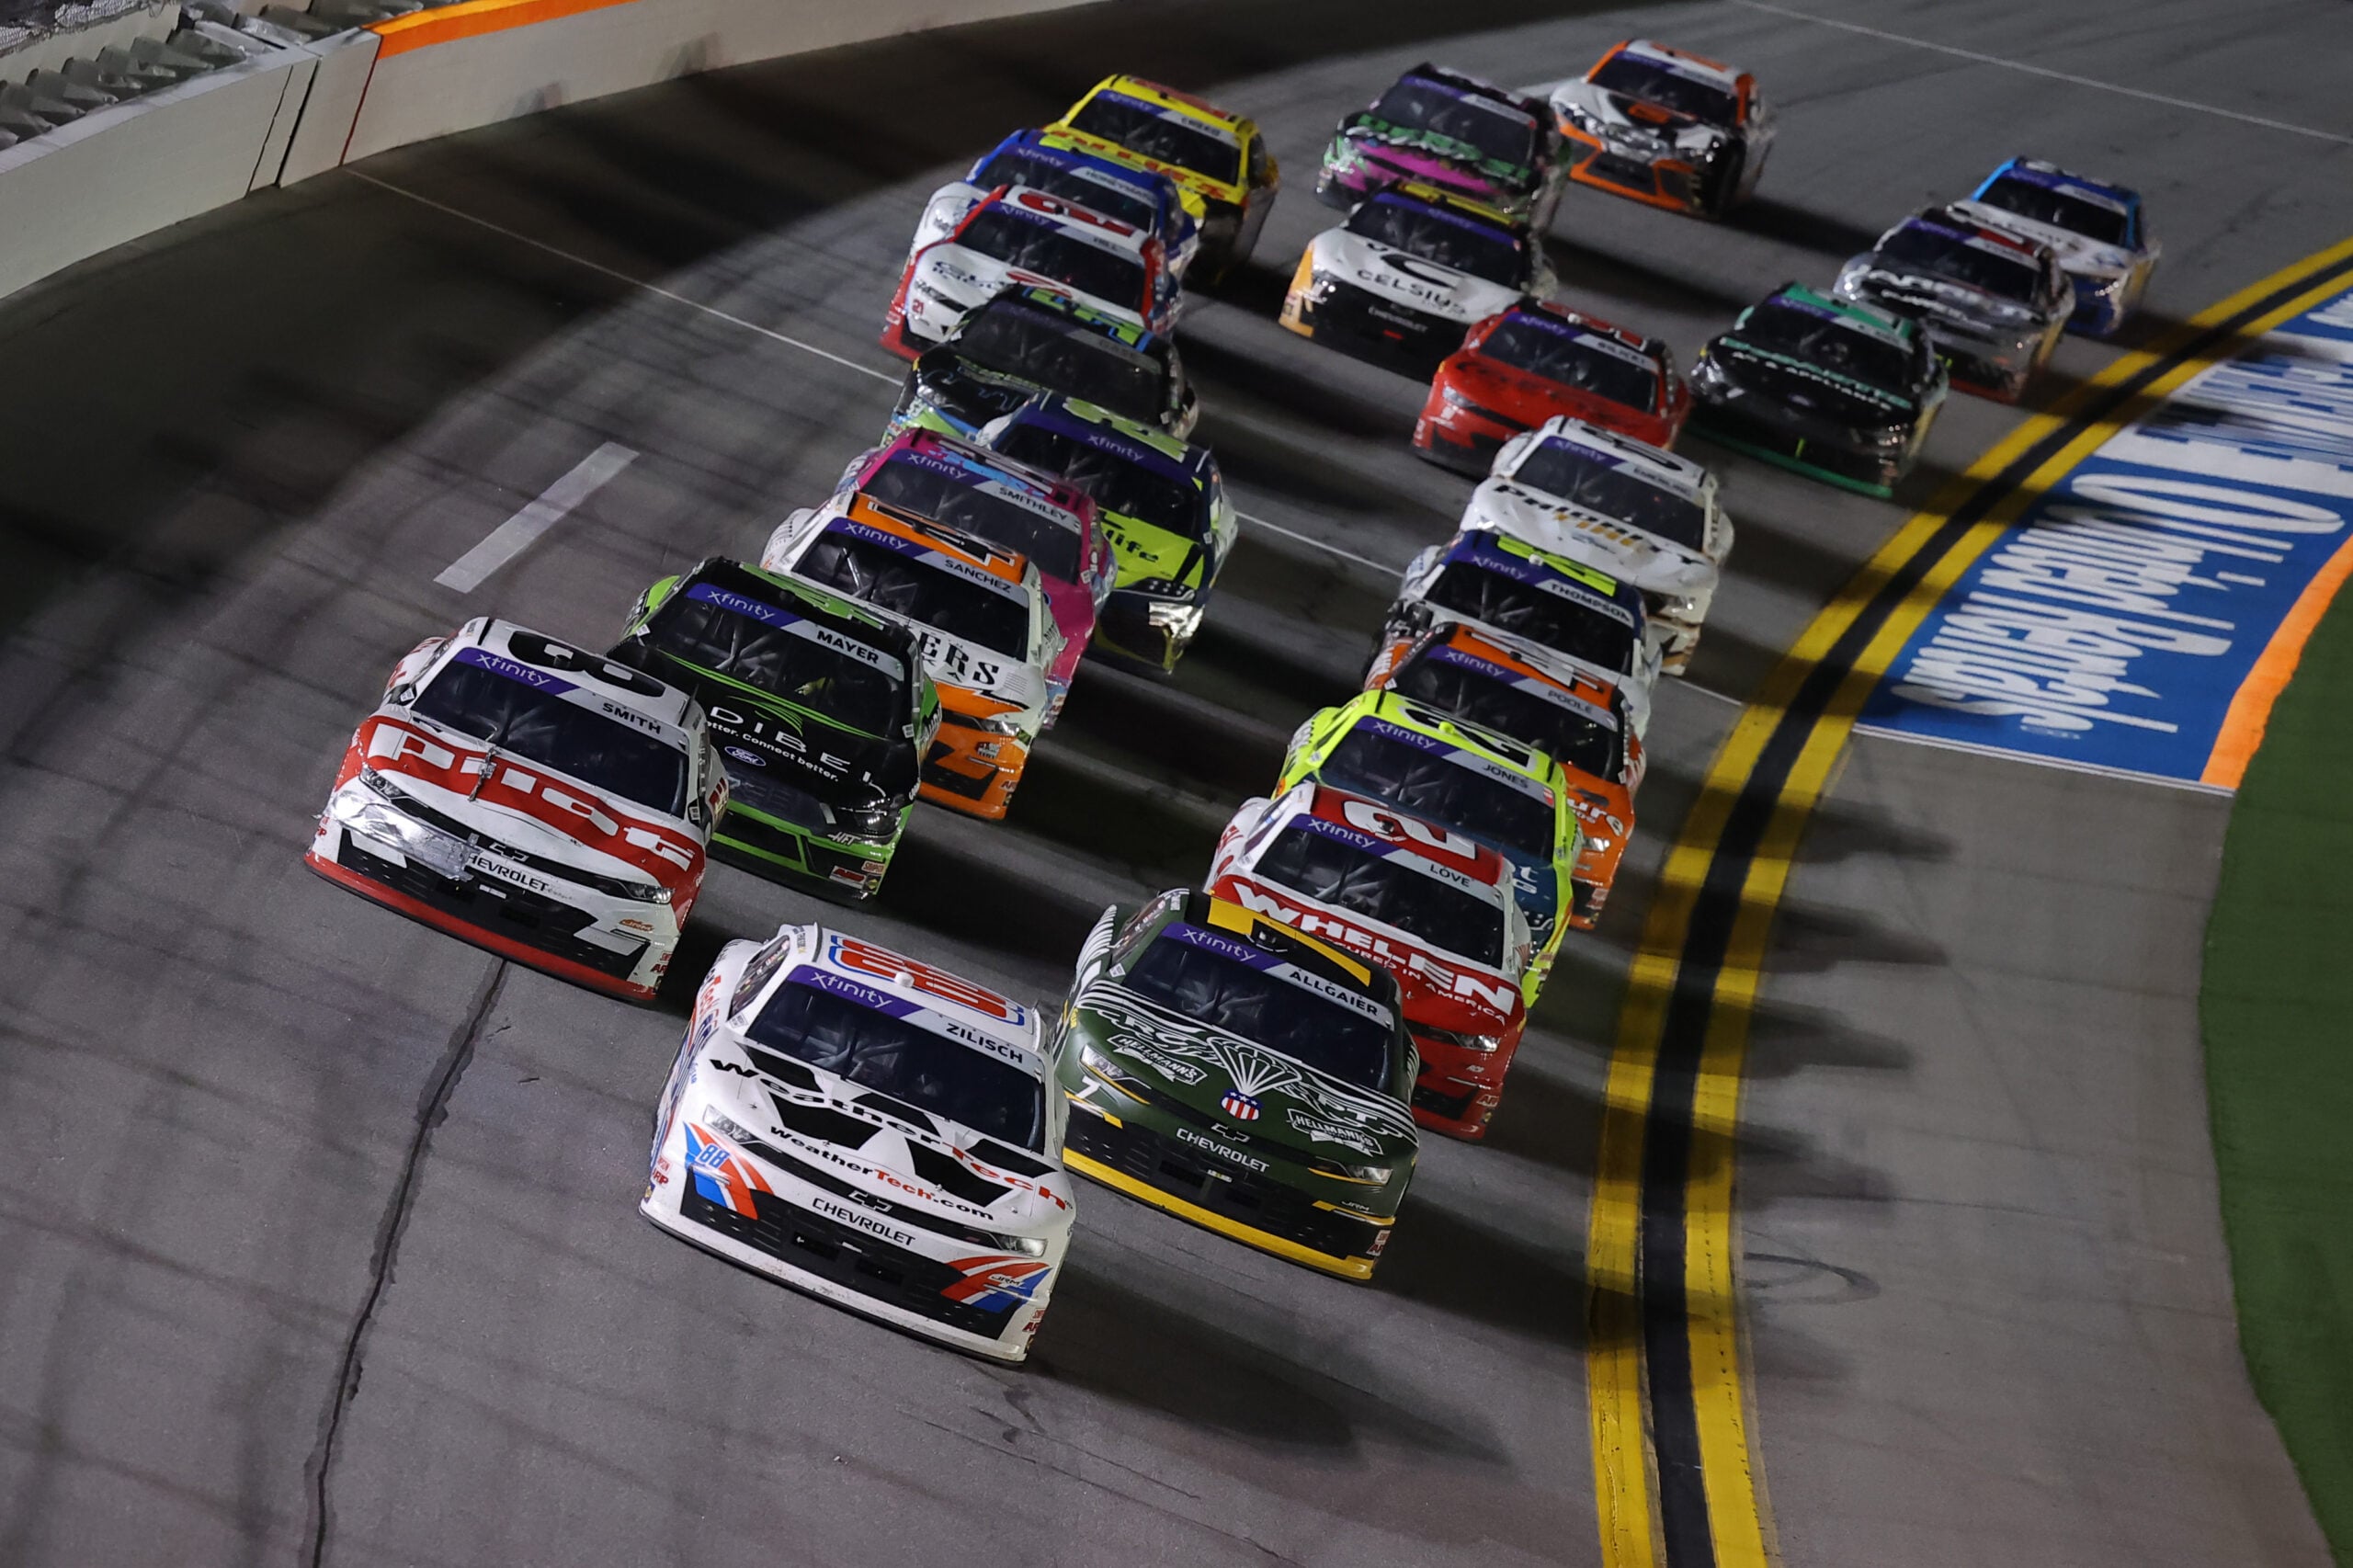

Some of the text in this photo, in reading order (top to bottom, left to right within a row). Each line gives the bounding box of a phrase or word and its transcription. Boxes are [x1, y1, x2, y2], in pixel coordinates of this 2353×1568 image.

[1357, 268, 1467, 316] CELSIUS
[1087, 434, 1145, 462] xfinity
[907, 452, 969, 480] xfinity
[998, 485, 1070, 522] SMITHLEY
[844, 521, 910, 551] xfinity
[945, 558, 1013, 594] SANCHEZ
[1472, 553, 1528, 581] xfinity
[708, 589, 776, 621] xfinity
[1549, 582, 1631, 623] THOMPSON
[816, 629, 881, 665] MAYER
[1444, 648, 1506, 678] xfinity
[474, 653, 551, 687] xfinity
[601, 700, 663, 735] SMITH
[1548, 688, 1595, 715] POOLE
[1373, 720, 1438, 750] xfinity
[742, 733, 795, 761] Connect
[797, 756, 838, 782] better.
[1482, 762, 1530, 790] JONES
[1306, 817, 1377, 849] xfinity
[1428, 862, 1472, 888] LOVE
[1181, 927, 1259, 962] xfinity
[1232, 881, 1518, 1017] WHELEN
[810, 971, 895, 1009] xfinity
[1289, 970, 1380, 1017] ALLGAIER
[1402, 967, 1422, 982] IN
[1425, 982, 1506, 1027] AMERICA
[945, 1022, 1024, 1065] ZILISCH
[710, 1057, 1068, 1211] WeatherTech
[1175, 1126, 1271, 1175] CHEVROLET
[697, 1143, 731, 1169] 88
[811, 1196, 917, 1248] CHEVROLET
